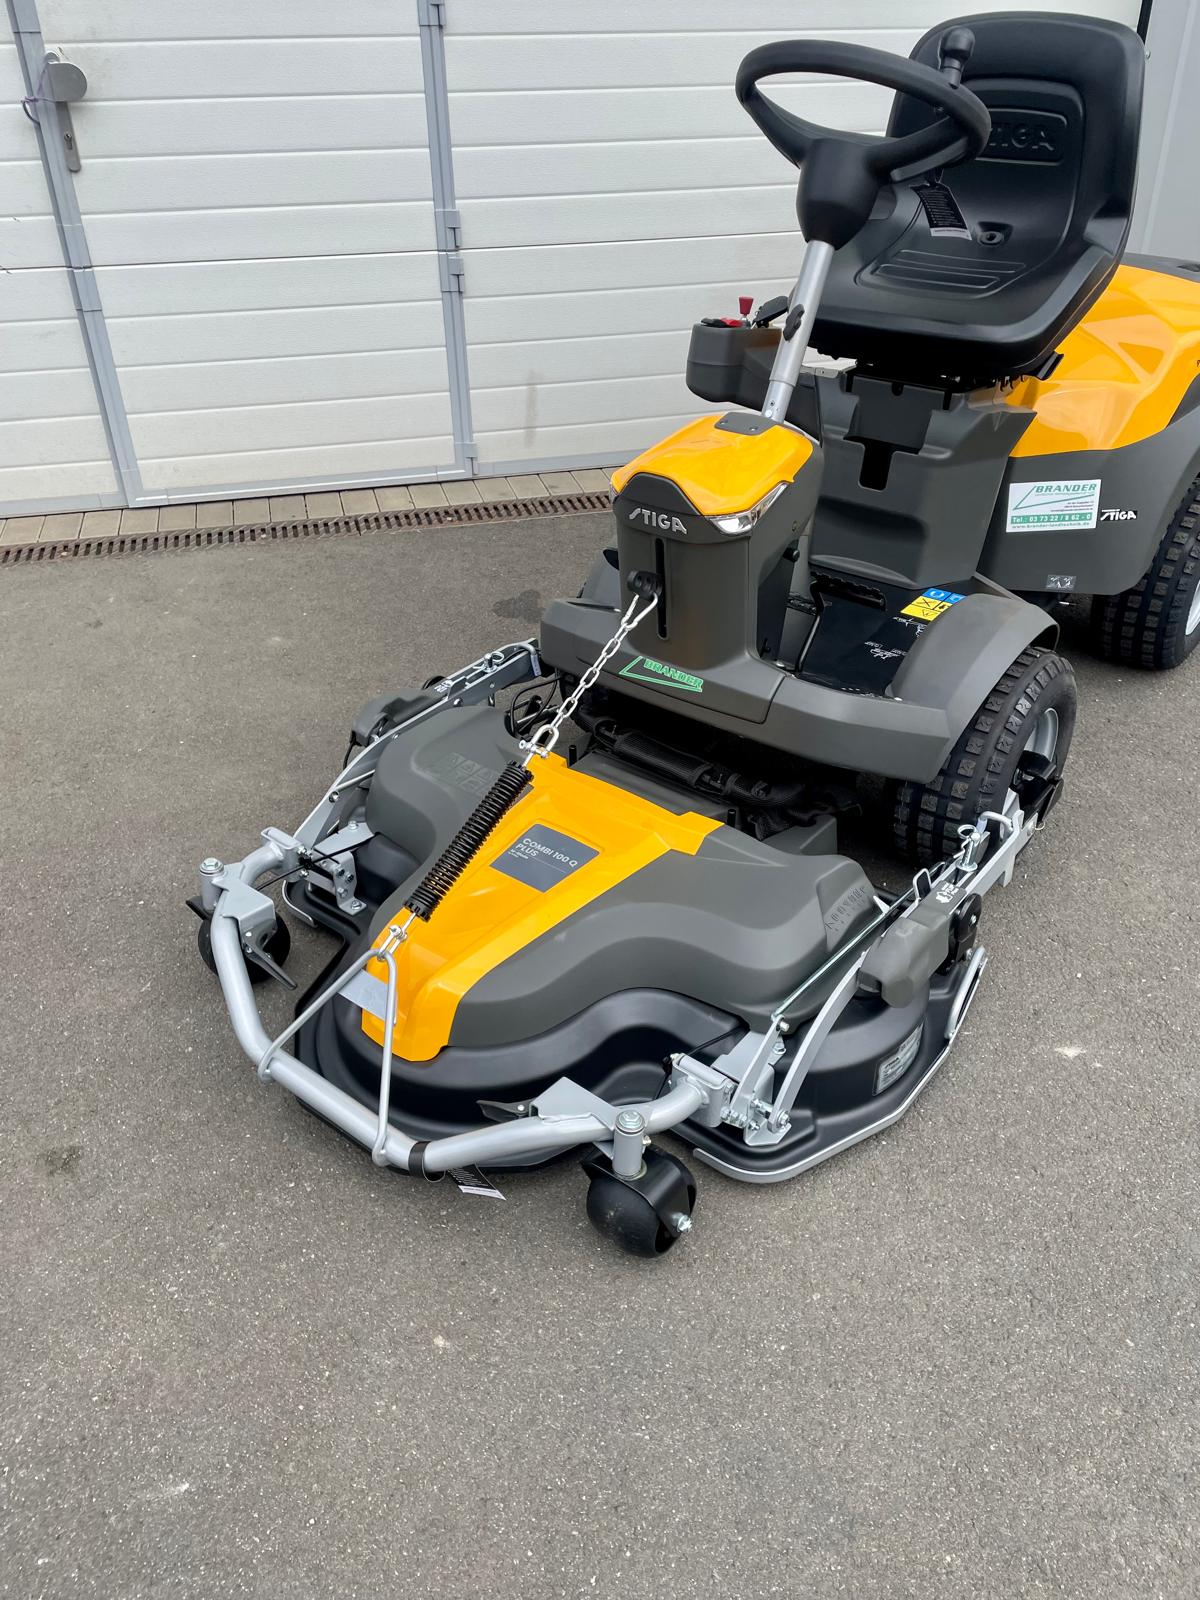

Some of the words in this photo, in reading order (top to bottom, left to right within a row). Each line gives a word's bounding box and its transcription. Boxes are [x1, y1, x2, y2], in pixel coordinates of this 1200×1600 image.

[988, 122, 1055, 151] TIGA
[1035, 483, 1097, 493] BRANDER
[629, 507, 687, 535] STIGA
[1100, 509, 1137, 521] STIGA
[643, 657, 704, 689] BRANDER
[515, 843, 539, 857] PLUS
[522, 838, 555, 856] COMBI
[552, 851, 570, 863] 100
[568, 859, 578, 868] Q
